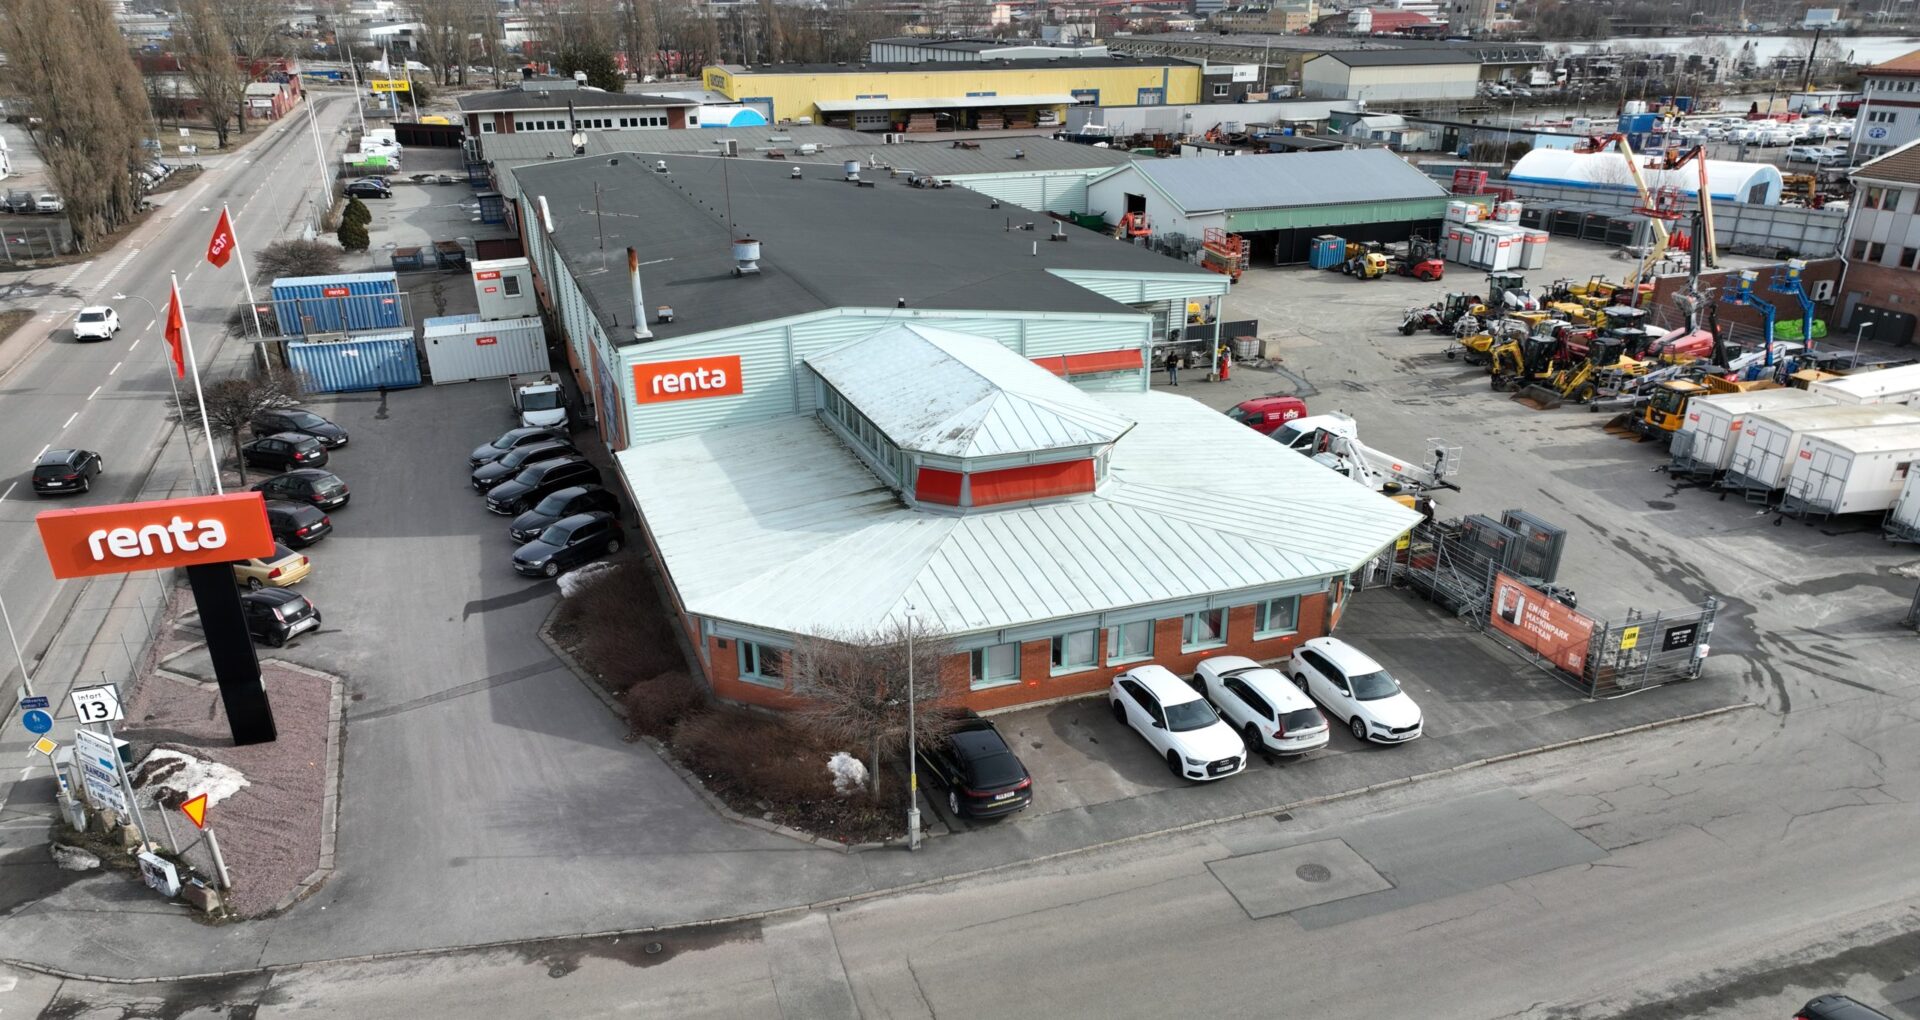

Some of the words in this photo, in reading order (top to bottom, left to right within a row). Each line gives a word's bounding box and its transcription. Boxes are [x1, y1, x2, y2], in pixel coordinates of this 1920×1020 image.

[652, 367, 727, 394] renta
[88, 515, 227, 561] renta
[78, 692, 102, 701] Infart
[80, 701, 109, 721] 13
